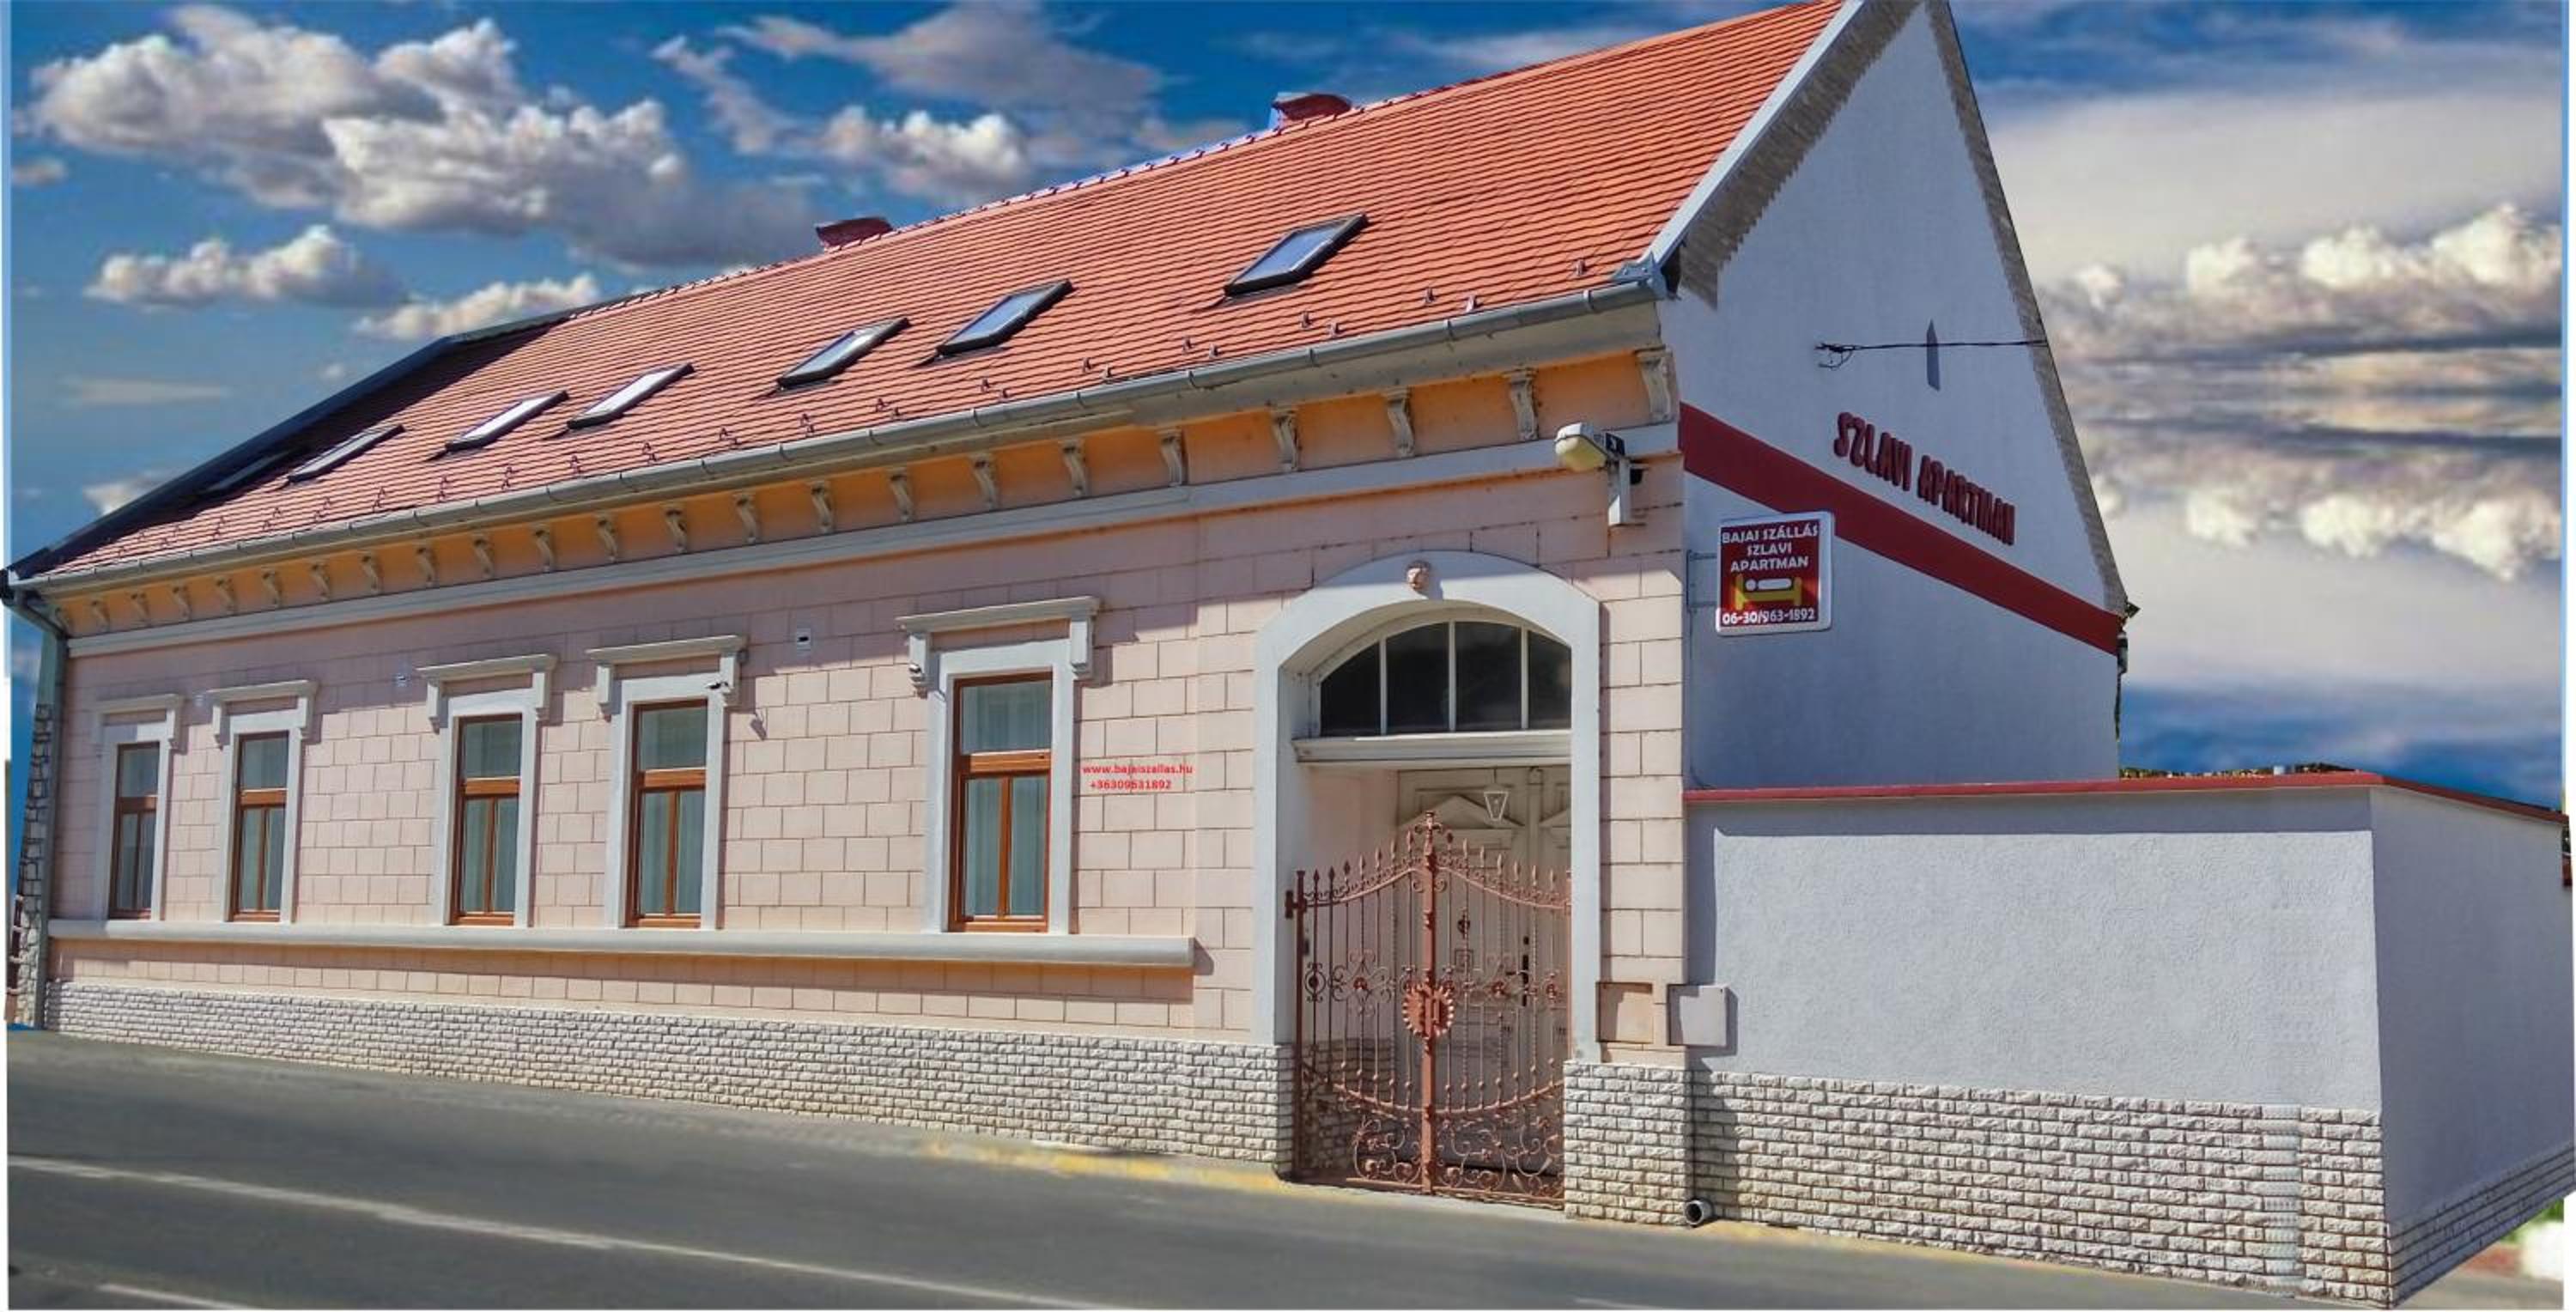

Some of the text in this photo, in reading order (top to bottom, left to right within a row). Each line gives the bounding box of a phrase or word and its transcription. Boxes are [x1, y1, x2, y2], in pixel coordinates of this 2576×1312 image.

[1833, 412, 2015, 545] SZLAVI APARTMAN
[1722, 522, 1818, 544] BAJAI SZÁLLÁS
[1747, 542, 1793, 556] SZLAVI
[1730, 556, 1809, 572] APARTMAN
[1722, 608, 1814, 624] 06-30/963-1892
